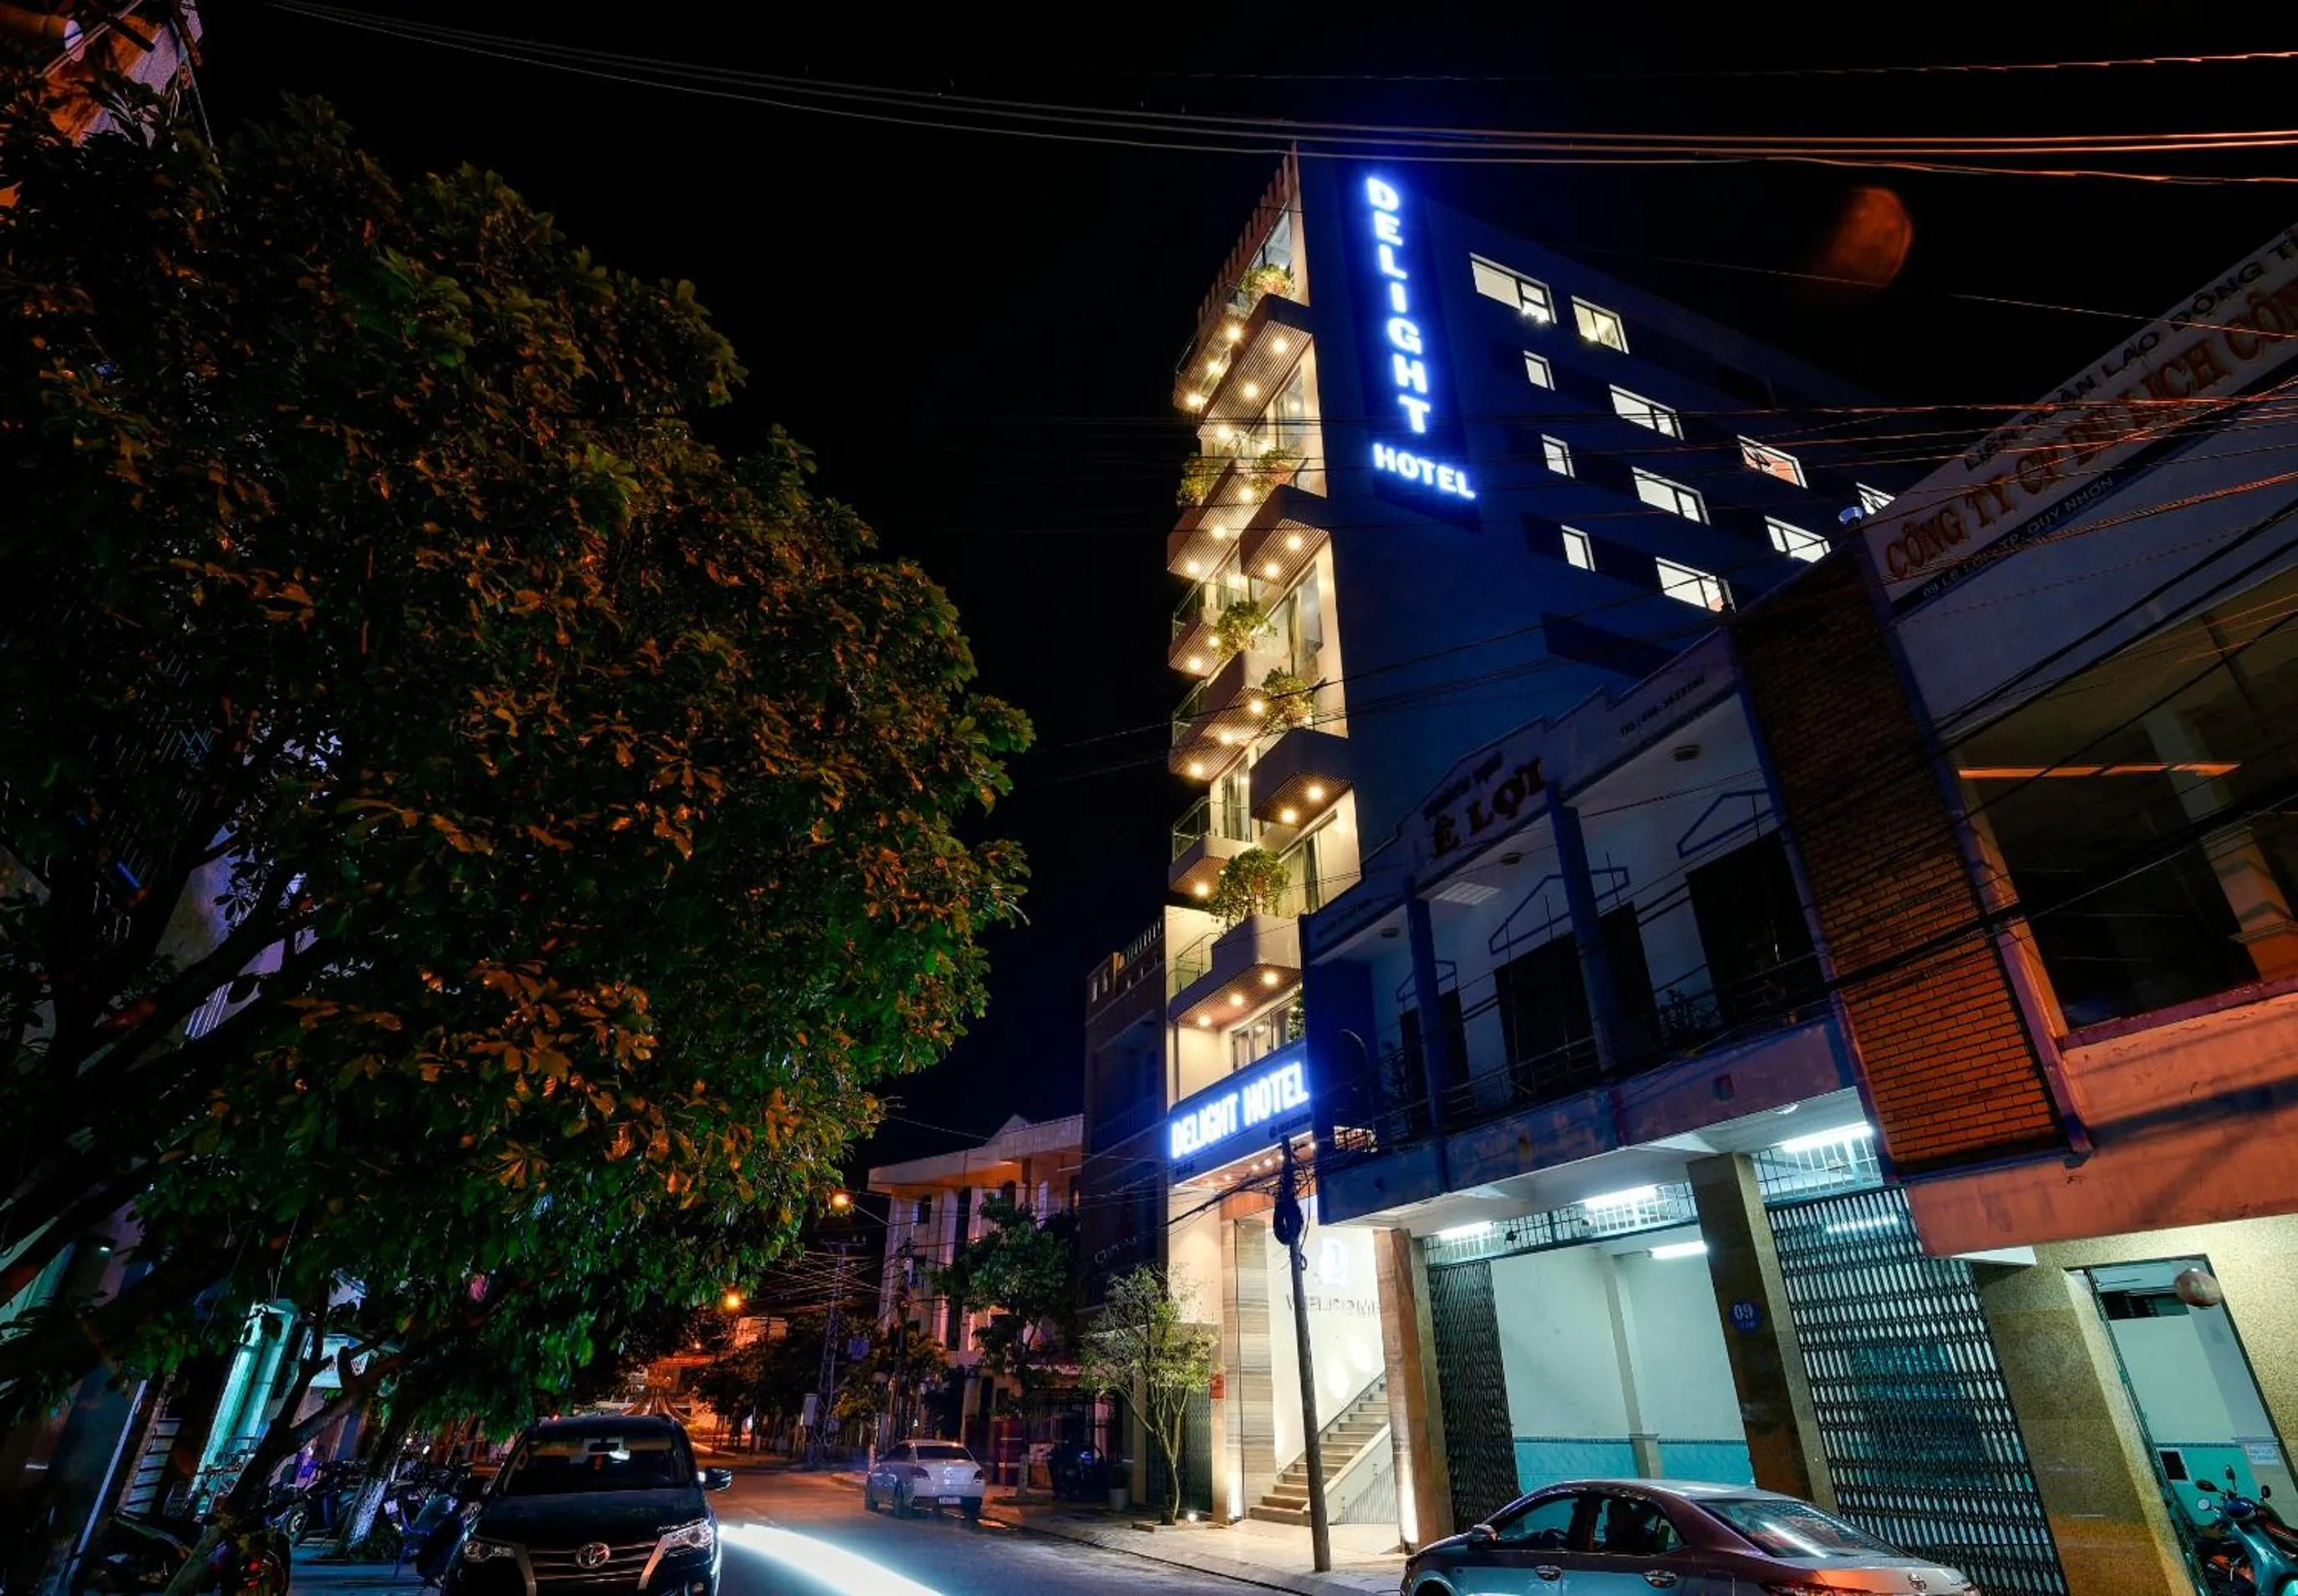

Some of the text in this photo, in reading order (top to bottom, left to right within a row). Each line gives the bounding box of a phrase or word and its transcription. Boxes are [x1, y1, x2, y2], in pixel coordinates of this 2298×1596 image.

[1365, 175, 1431, 435] DELIGHT
[2102, 332, 2160, 377] LAO
[1373, 442, 1477, 501] HOTEL
[1887, 505, 1965, 577] CÔNG
[1967, 475, 2015, 527] TY
[1171, 1061, 1309, 1159] DELIGHT HOTEL
[1733, 1303, 1753, 1320] 09
